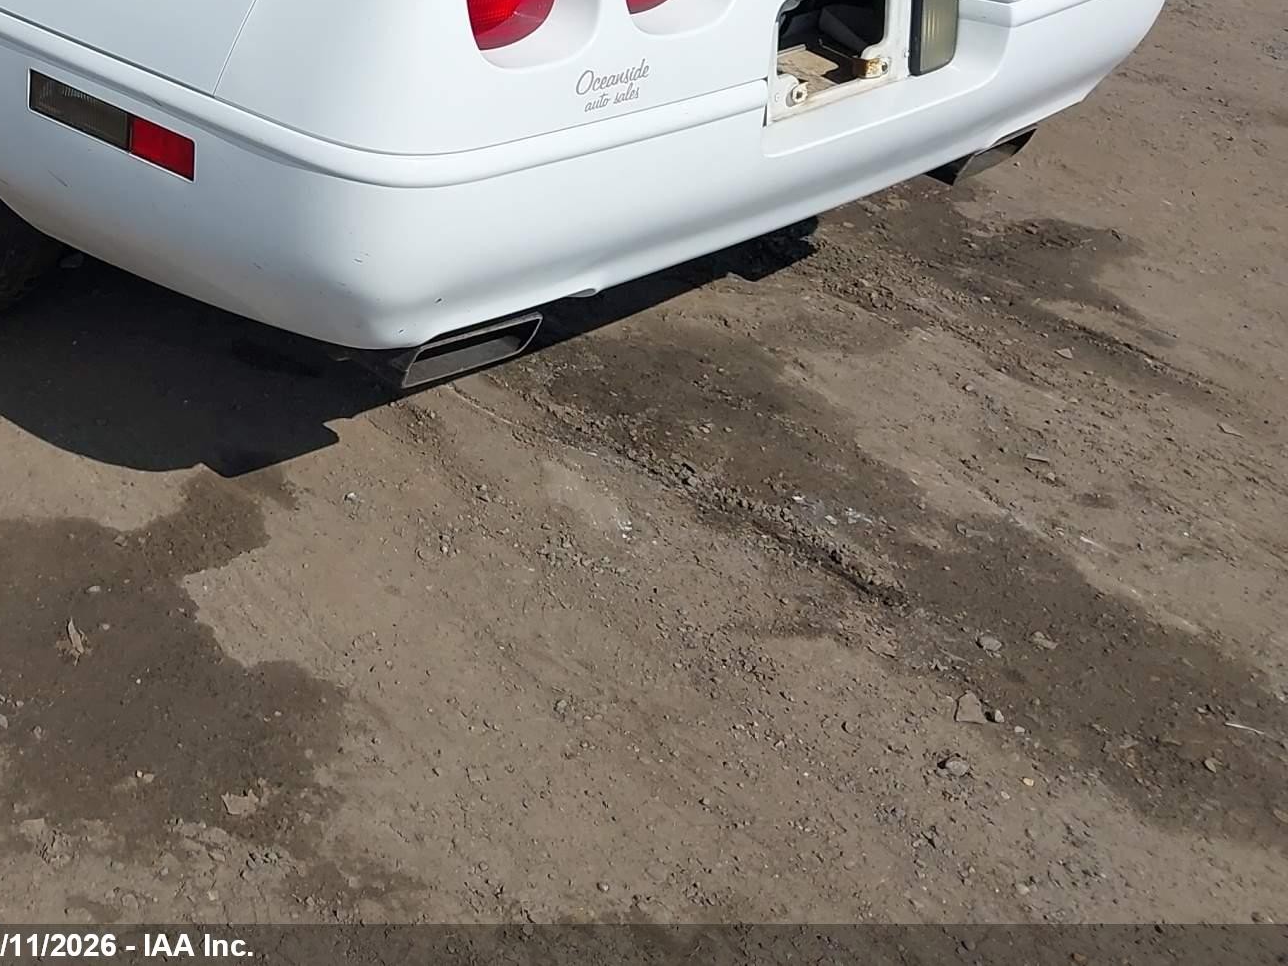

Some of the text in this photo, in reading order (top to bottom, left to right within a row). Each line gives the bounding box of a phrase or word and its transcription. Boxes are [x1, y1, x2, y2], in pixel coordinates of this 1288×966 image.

[575, 58, 650, 96] Oceanside
[584, 81, 640, 113] auto sales
